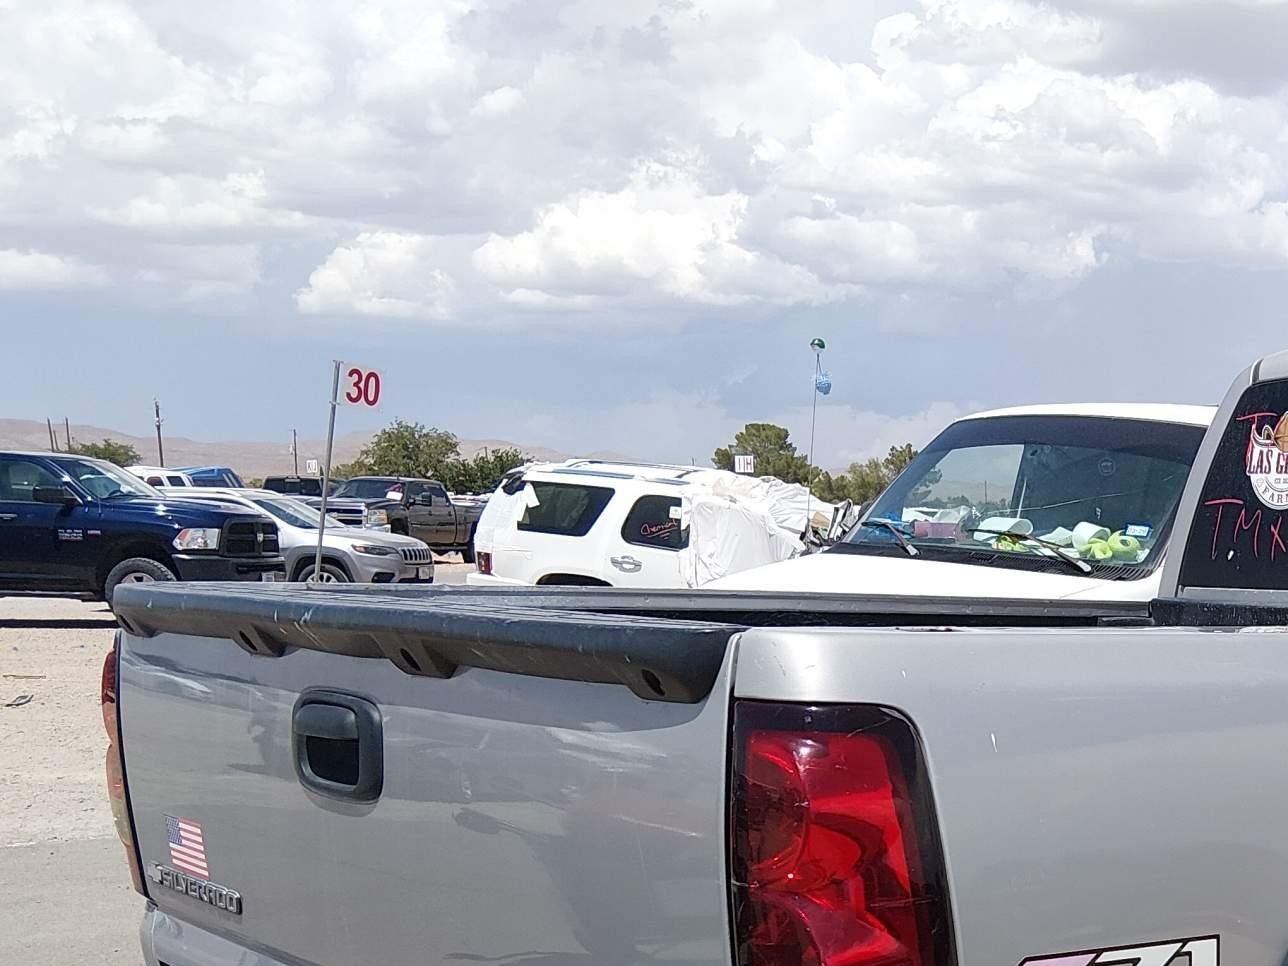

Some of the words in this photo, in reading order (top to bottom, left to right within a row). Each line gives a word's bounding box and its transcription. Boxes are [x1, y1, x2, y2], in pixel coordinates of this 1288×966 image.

[345, 368, 380, 406] 30
[1247, 448, 1273, 475] LAS
[161, 868, 242, 914] SILVERADO
